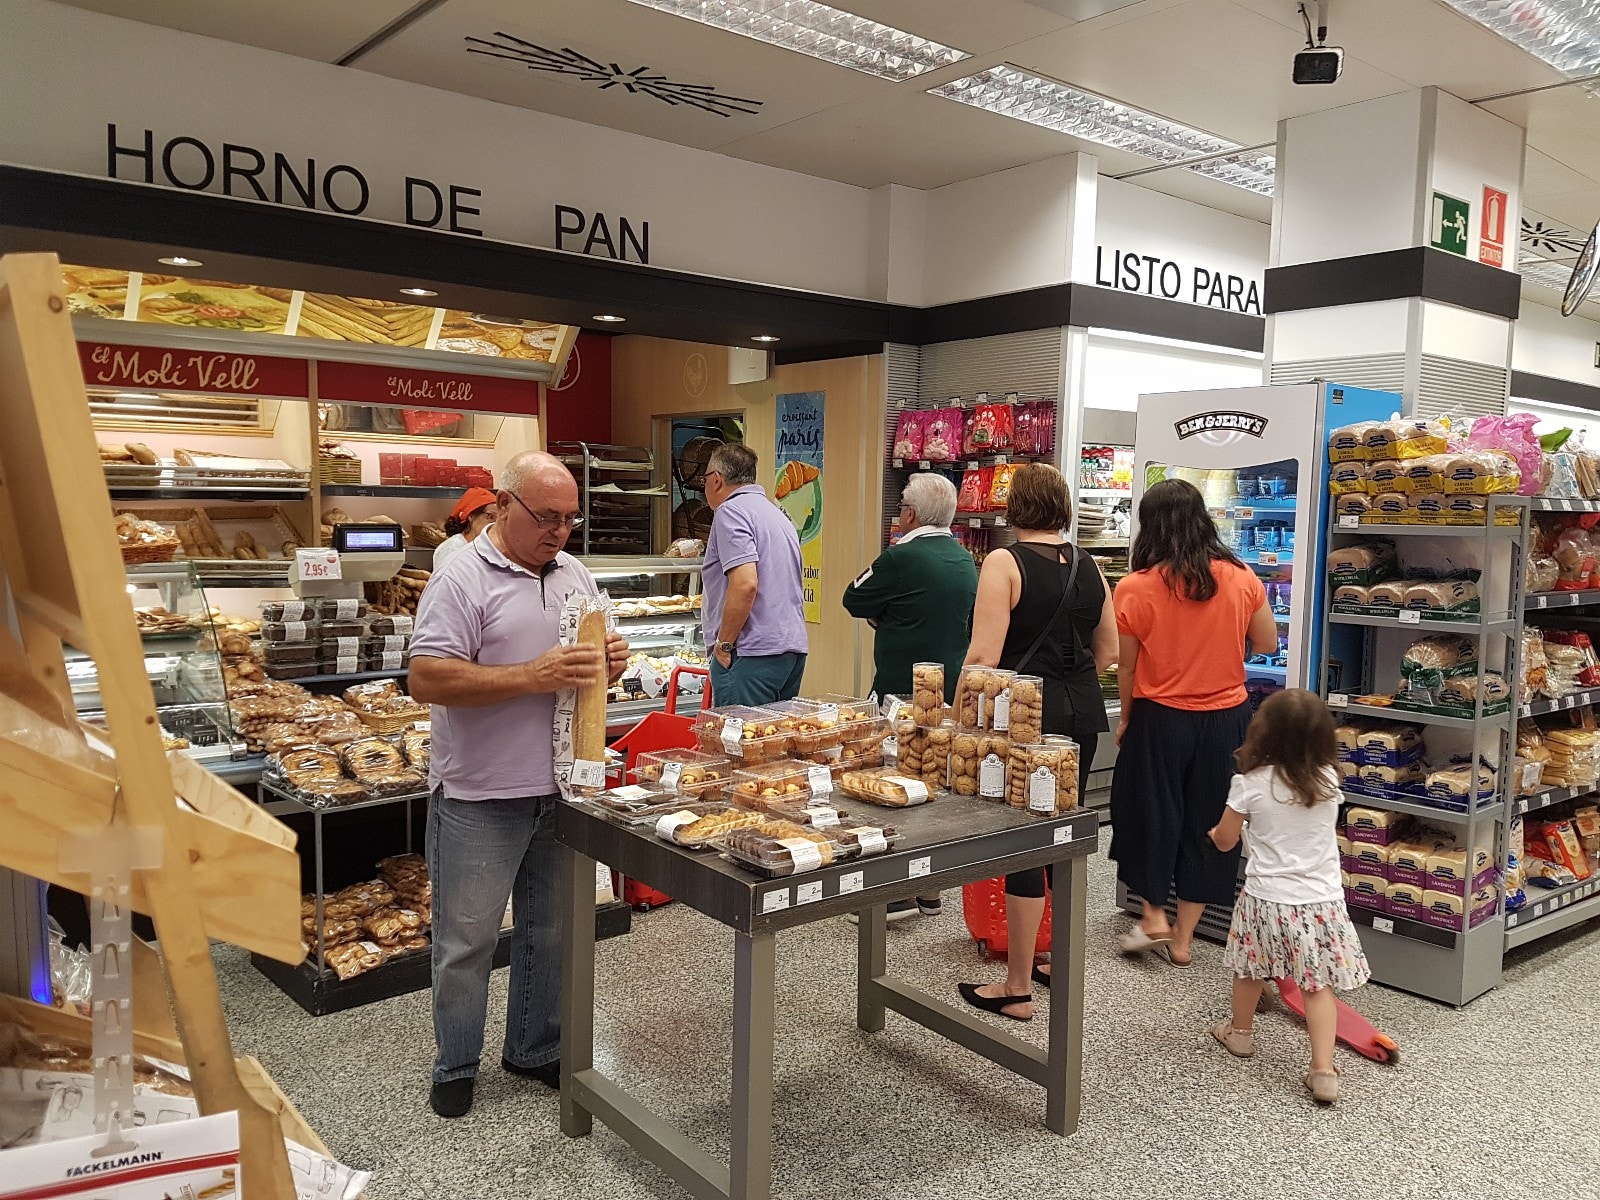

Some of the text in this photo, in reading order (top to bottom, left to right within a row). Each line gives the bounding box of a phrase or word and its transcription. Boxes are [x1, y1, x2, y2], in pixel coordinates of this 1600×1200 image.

[107, 122, 649, 265] HORNO DE PAN
[1095, 245, 1261, 316] LISTO PARA
[188, 354, 260, 390] Vell
[436, 380, 474, 401] Vell
[304, 561, 329, 577] 2,95€
[803, 564, 820, 580] sabor
[66, 1151, 162, 1178] FACKELMANN
